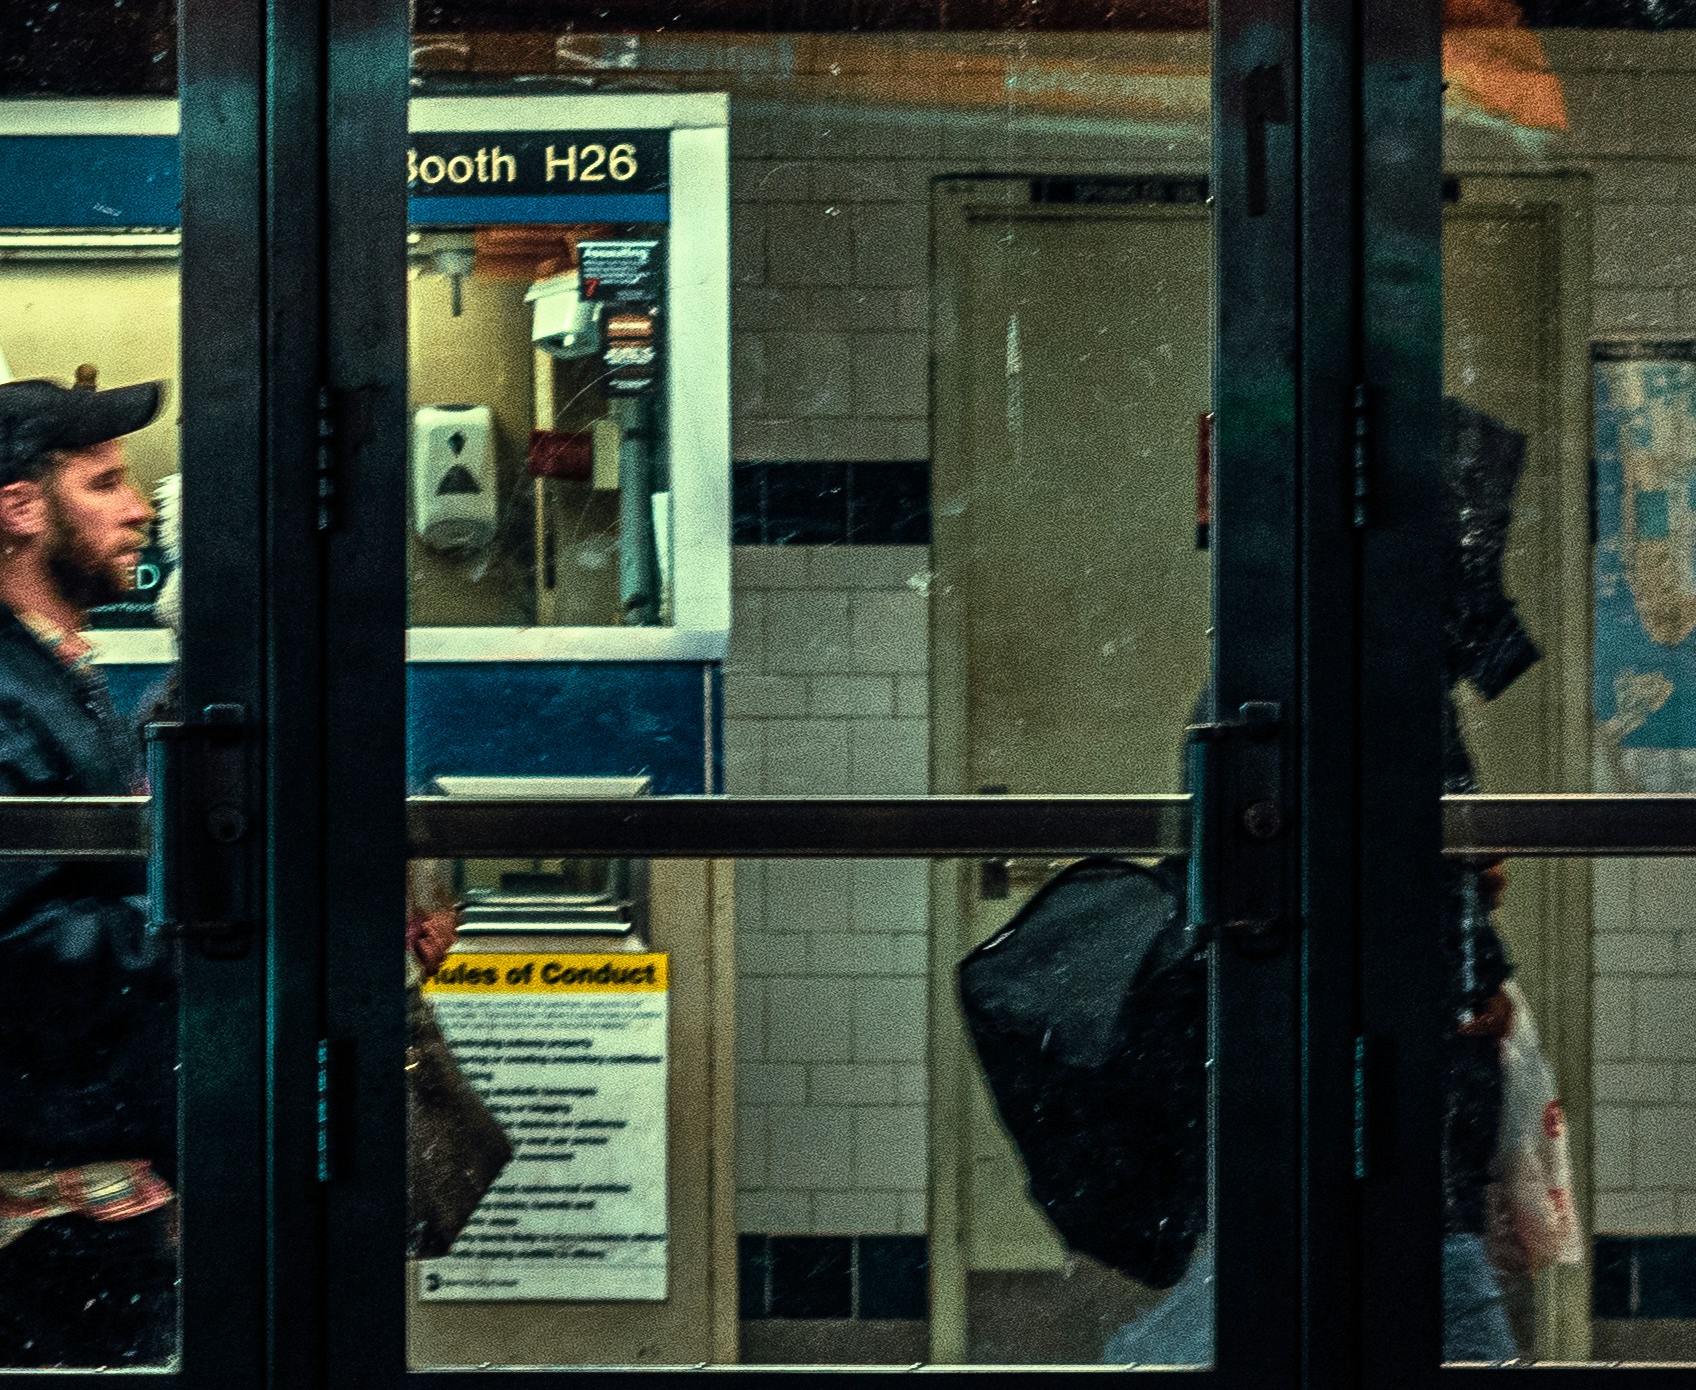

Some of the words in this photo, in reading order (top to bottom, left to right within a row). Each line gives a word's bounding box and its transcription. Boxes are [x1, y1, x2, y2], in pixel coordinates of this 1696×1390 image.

[544, 142, 640, 184] H26
[505, 960, 537, 987] of
[540, 960, 658, 987] Conduct
